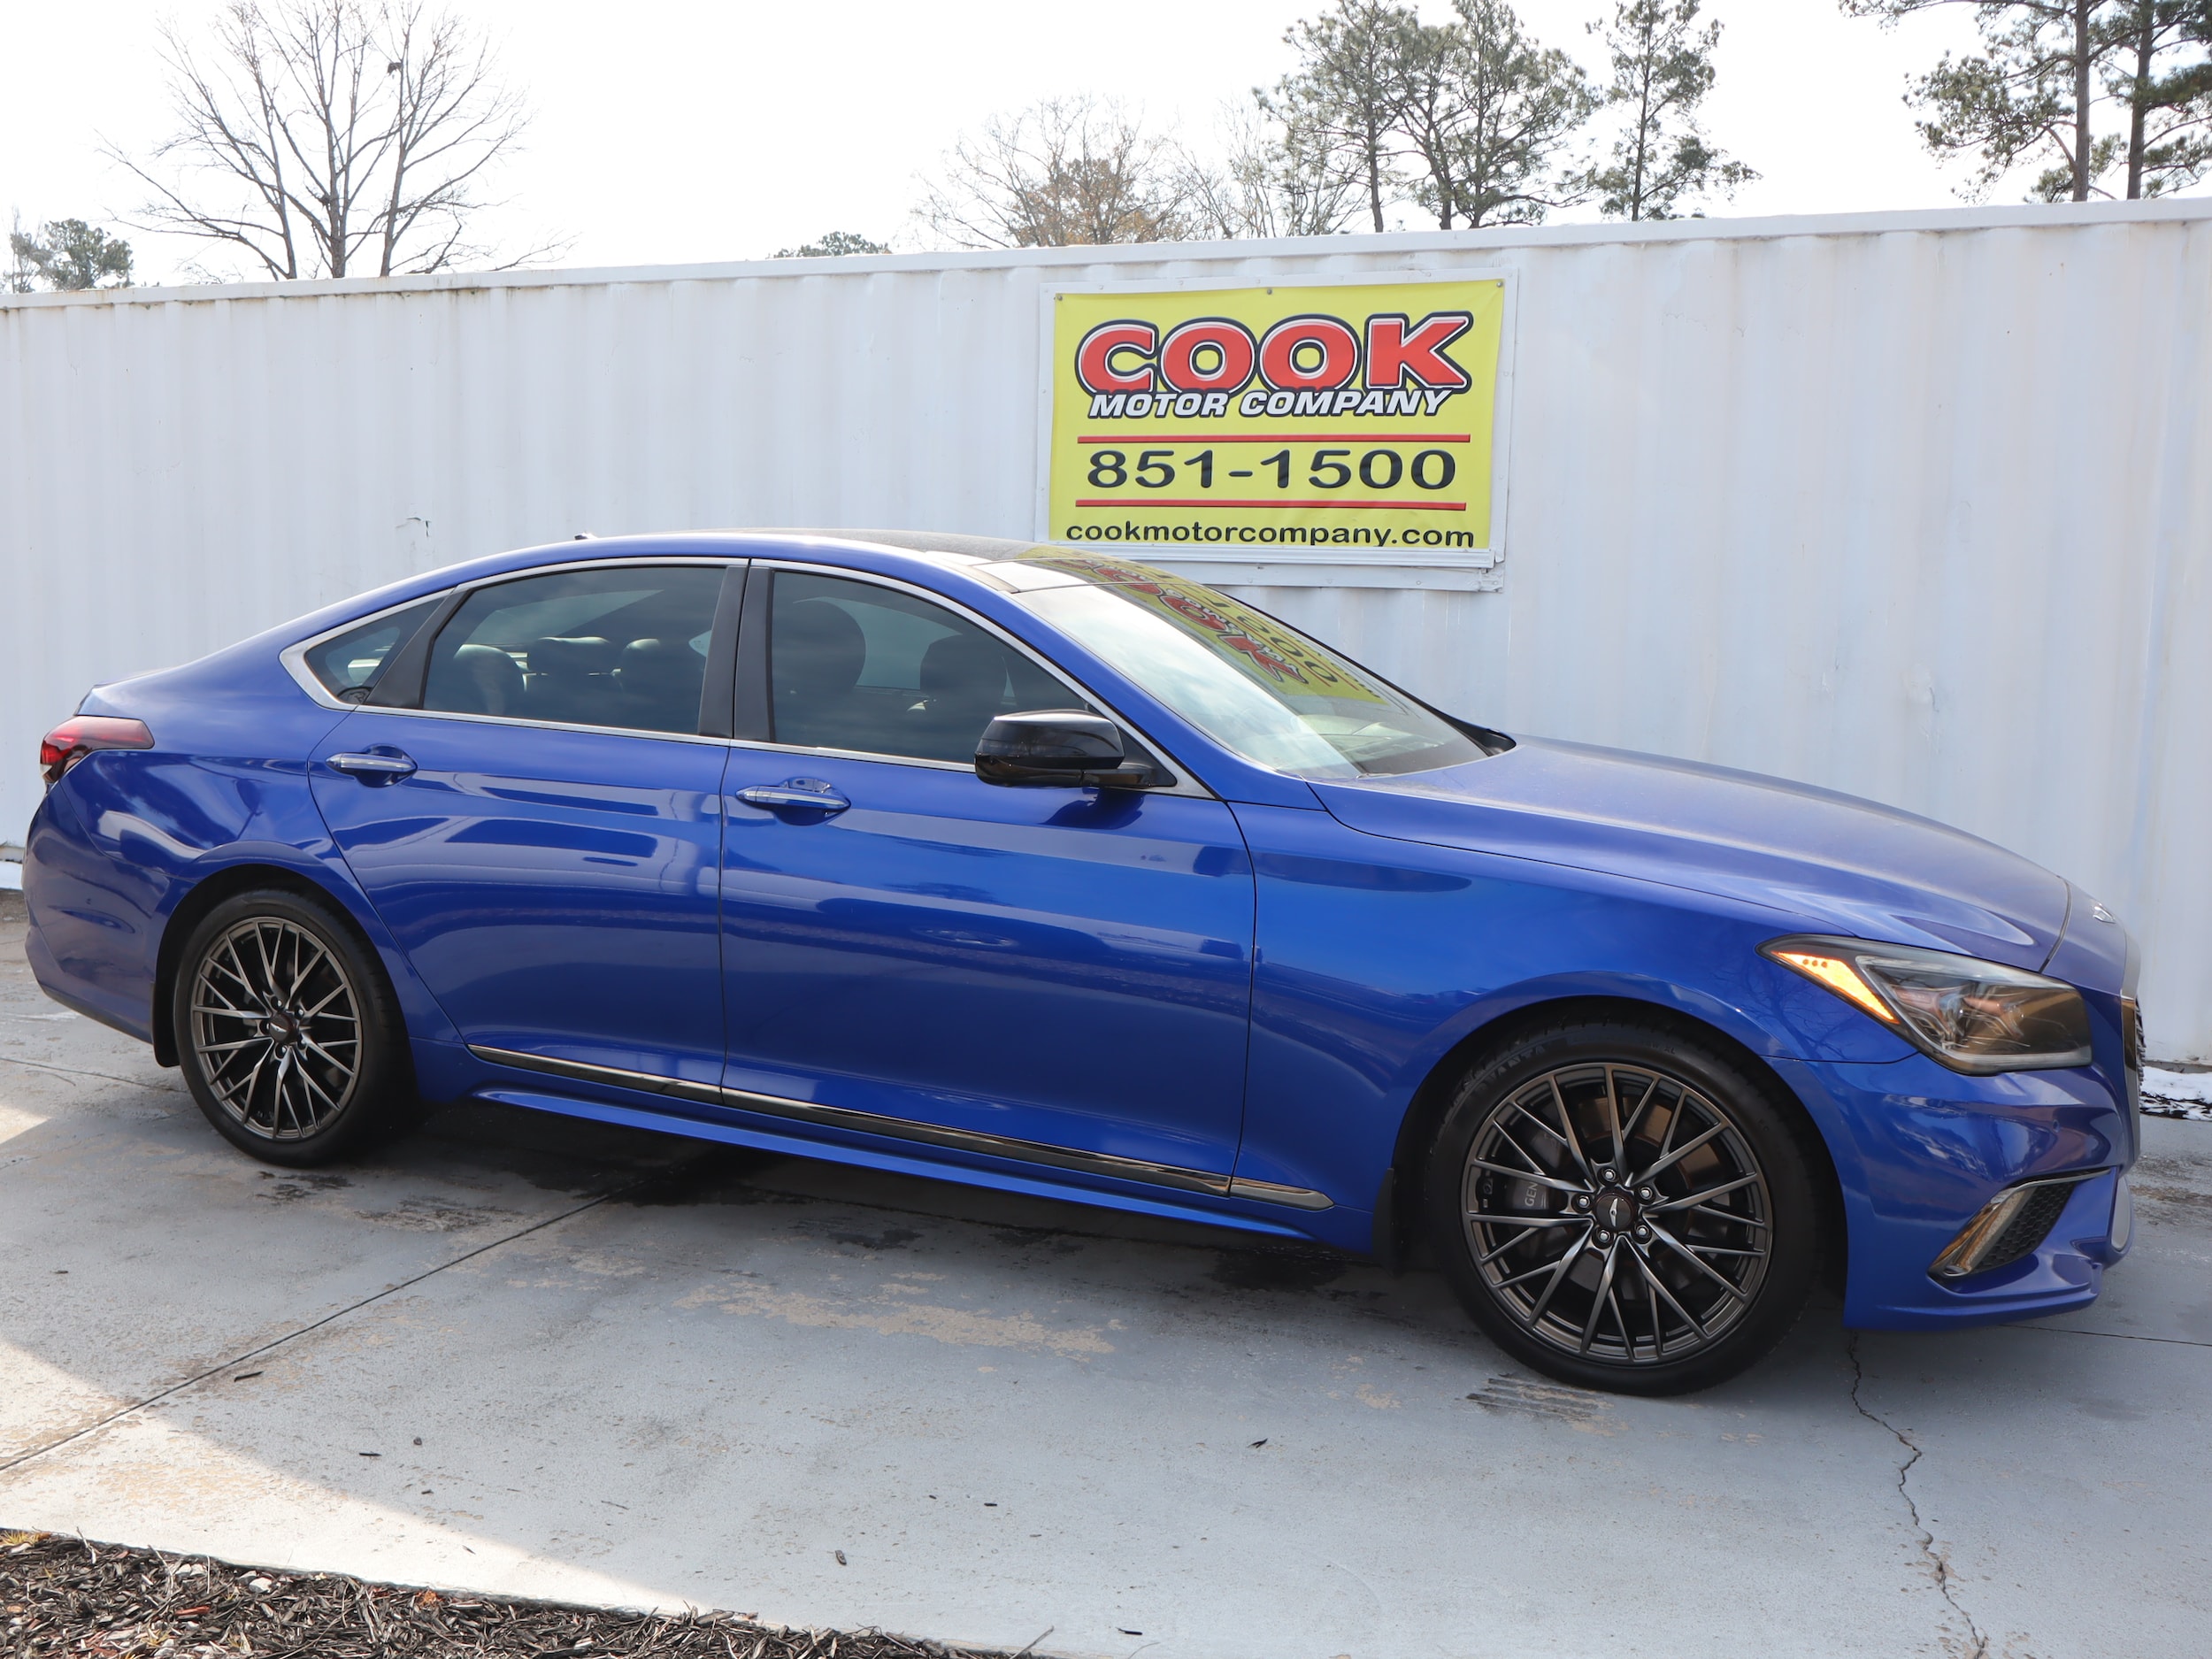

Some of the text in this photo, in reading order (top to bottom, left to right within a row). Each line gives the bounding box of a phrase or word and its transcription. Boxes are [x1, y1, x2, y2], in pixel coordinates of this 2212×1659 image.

[1075, 311, 1473, 394] COOK
[1087, 388, 1456, 419] MOTOR COMPANY
[1087, 449, 1455, 489] 851-1500
[1065, 520, 1474, 547] cookmotorcompany.com
